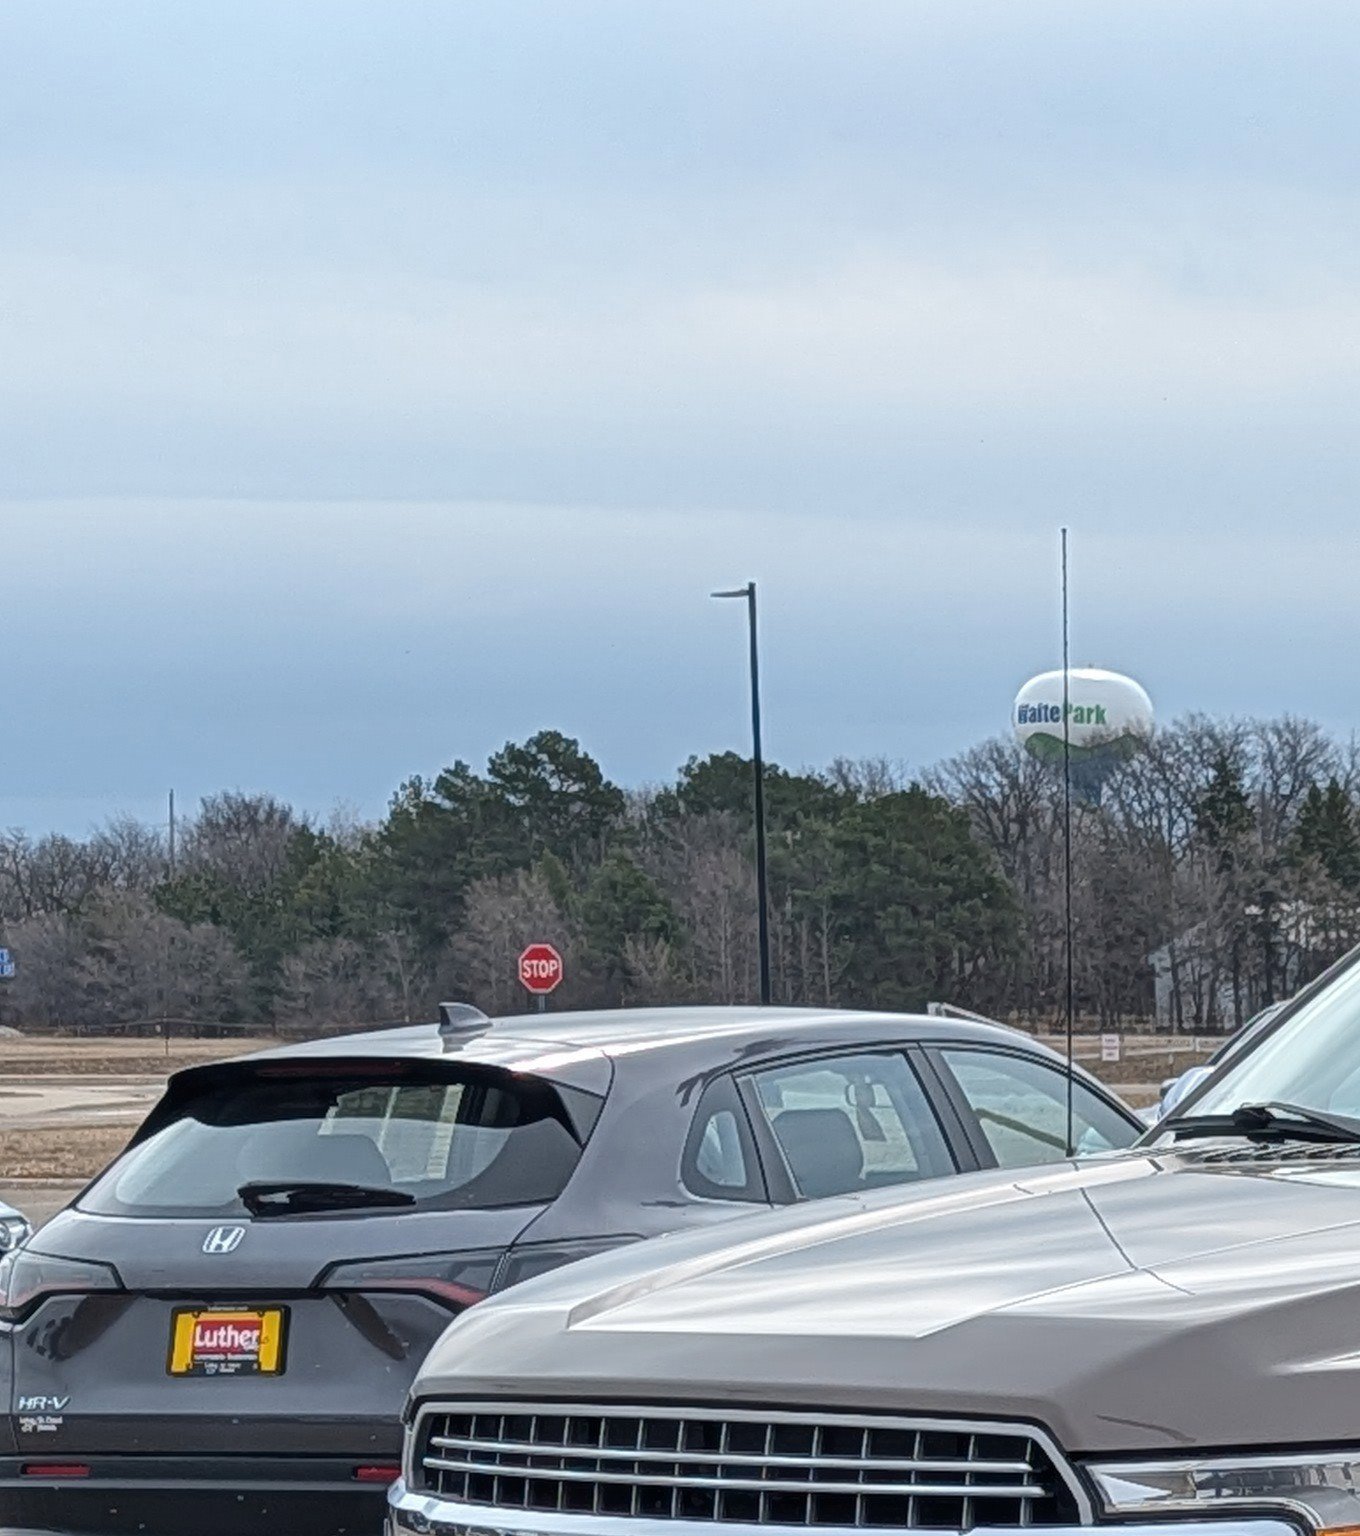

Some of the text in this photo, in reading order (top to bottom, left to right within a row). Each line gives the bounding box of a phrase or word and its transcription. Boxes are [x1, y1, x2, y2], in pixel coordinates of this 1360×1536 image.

[522, 960, 558, 978] STOP
[194, 1325, 260, 1348] Luther
[19, 1395, 71, 1410] HR-V
